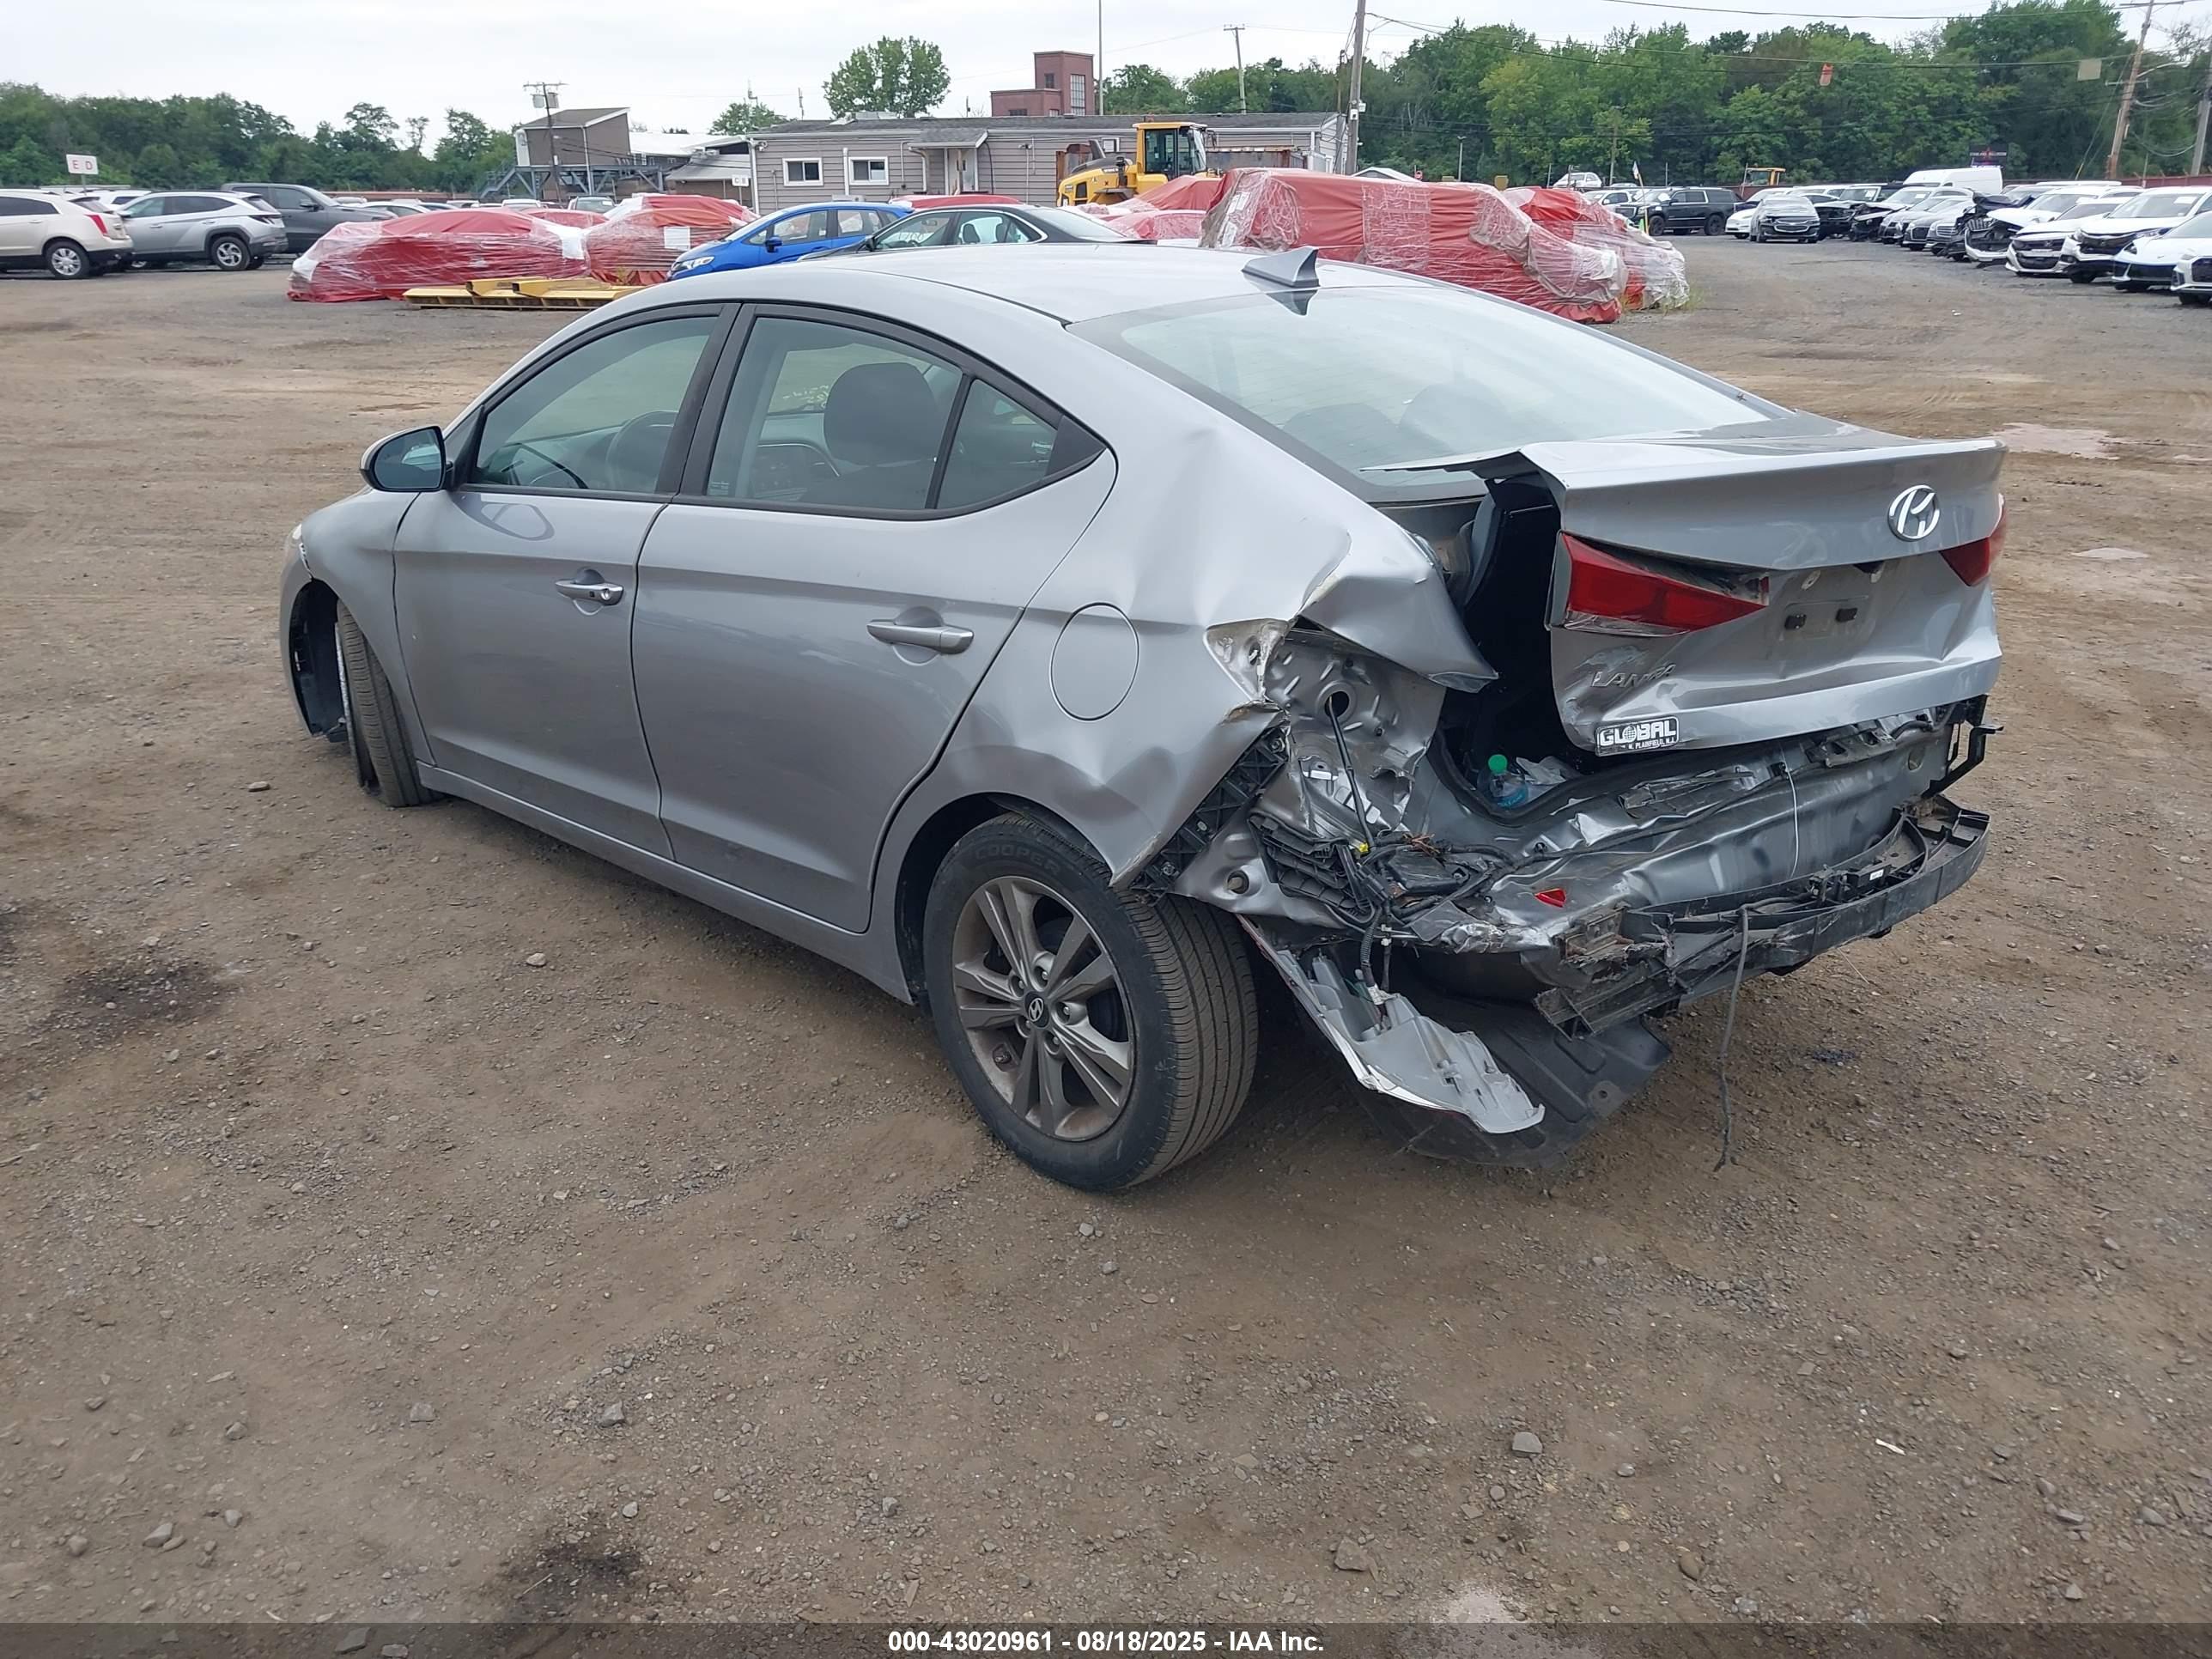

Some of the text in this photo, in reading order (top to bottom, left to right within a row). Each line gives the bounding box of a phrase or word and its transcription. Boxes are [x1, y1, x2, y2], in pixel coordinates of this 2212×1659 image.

[72, 160, 93, 170] E D
[1600, 720, 1676, 746] GLOBAL
[975, 843, 1060, 874] COOPER
